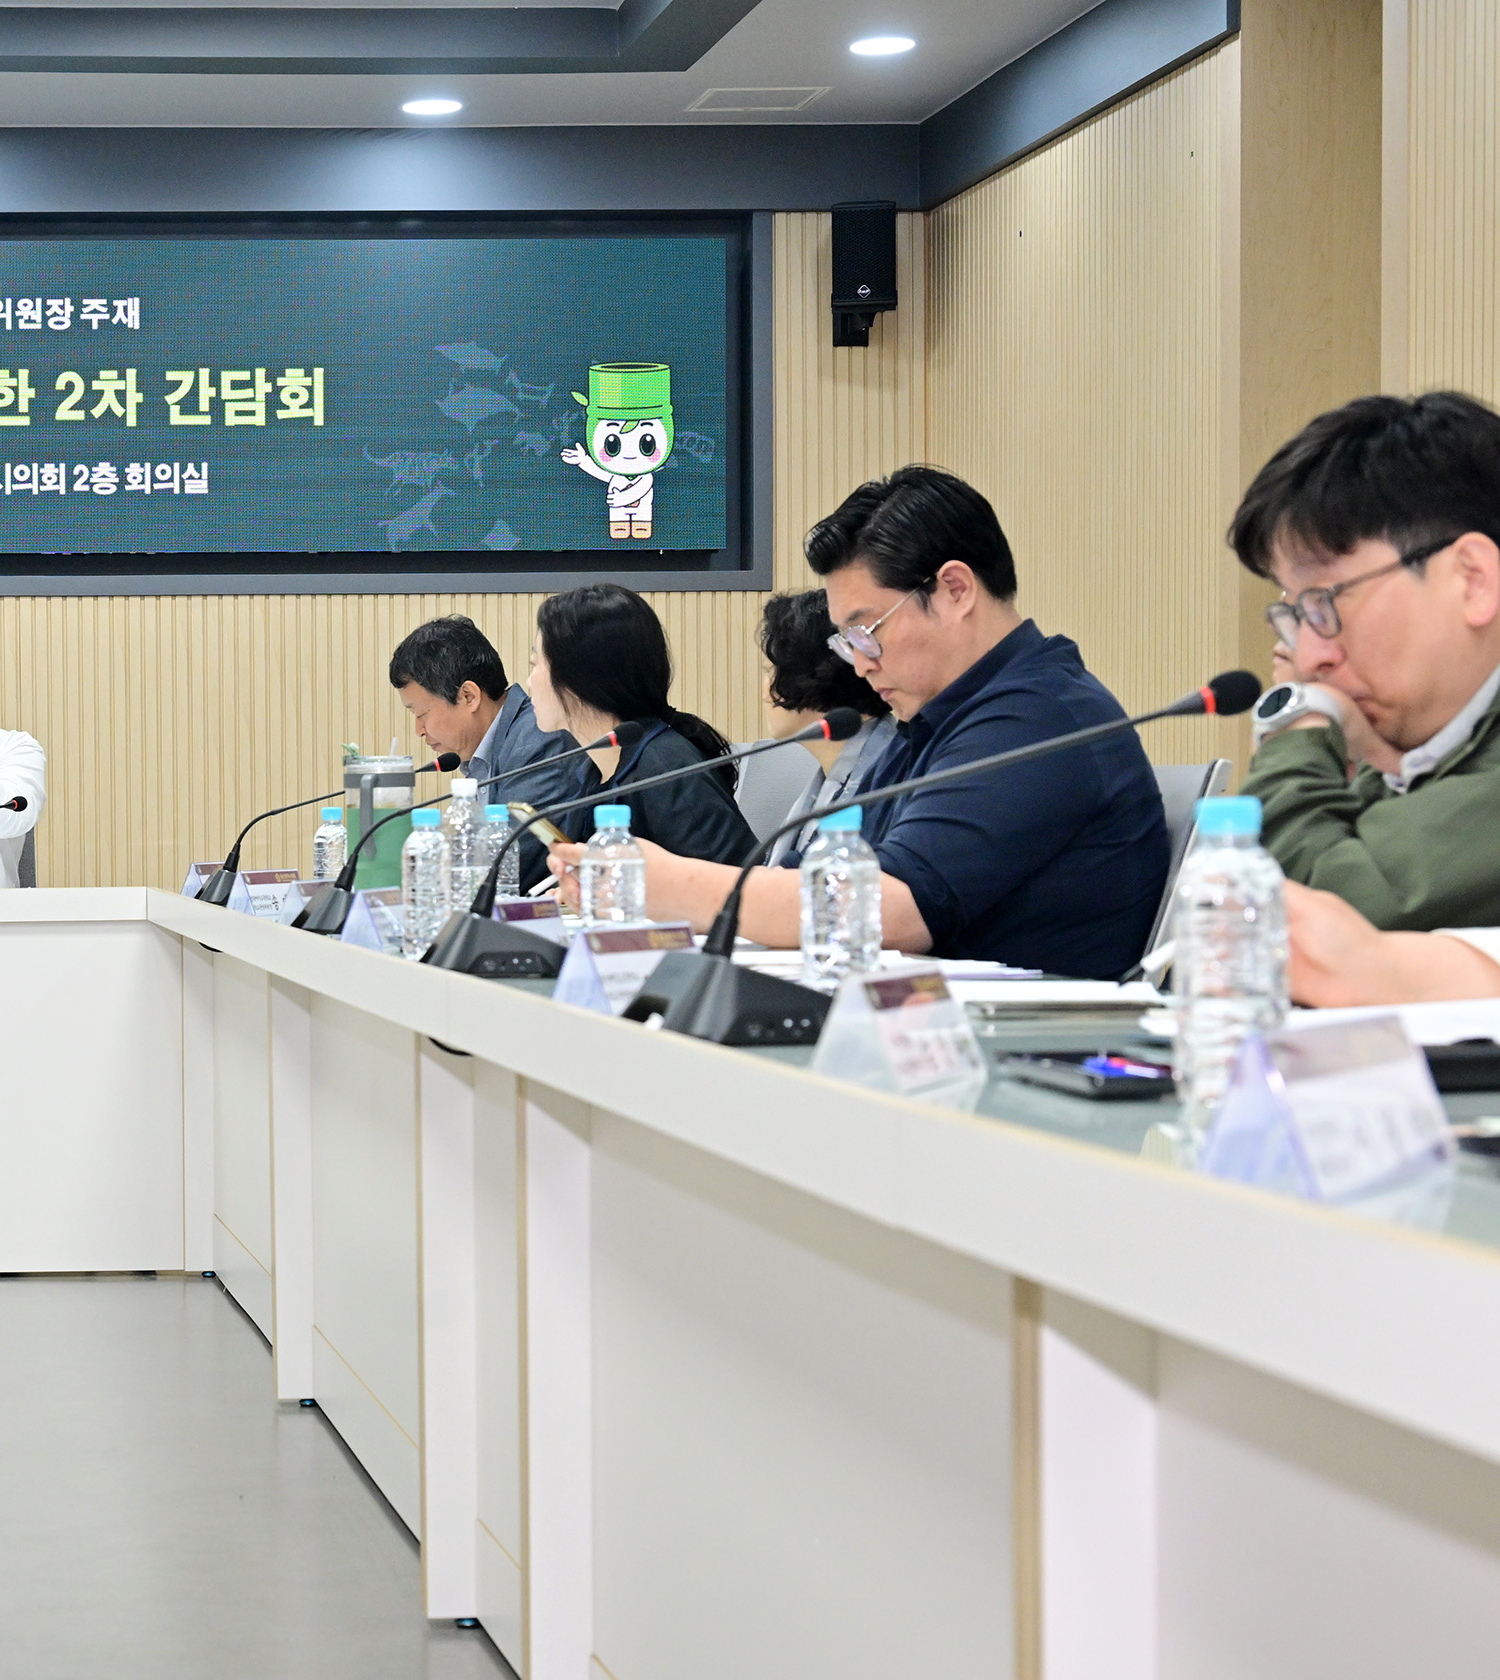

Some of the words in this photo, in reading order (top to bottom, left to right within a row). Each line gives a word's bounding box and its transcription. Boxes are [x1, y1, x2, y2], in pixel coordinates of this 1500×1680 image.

[79, 297, 140, 330] 주재
[55, 368, 144, 427] 2차
[164, 367, 325, 426] 간담회
[72, 462, 120, 495] 2층
[124, 462, 209, 495] 회의실
